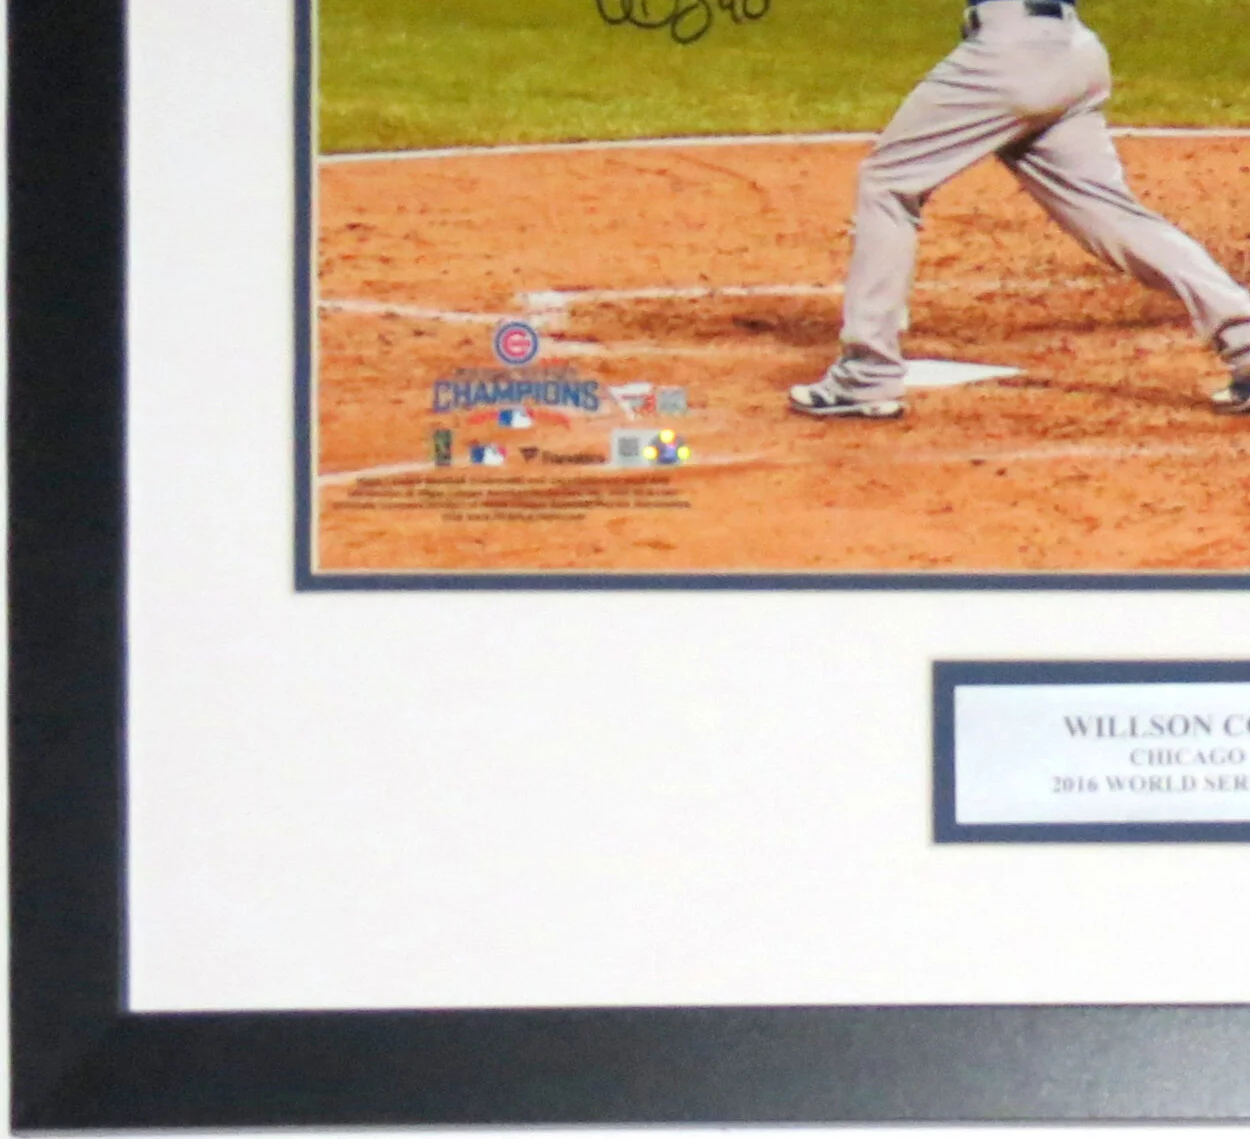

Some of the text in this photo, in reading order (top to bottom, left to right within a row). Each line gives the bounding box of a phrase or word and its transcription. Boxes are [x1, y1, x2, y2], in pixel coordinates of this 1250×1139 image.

[433, 379, 600, 413] CHAMPIONS
[1063, 714, 1212, 738] WILLSON
[1129, 747, 1246, 765] CHICAGO
[1052, 774, 1098, 793] 2016
[1106, 774, 1197, 792] WORLD
